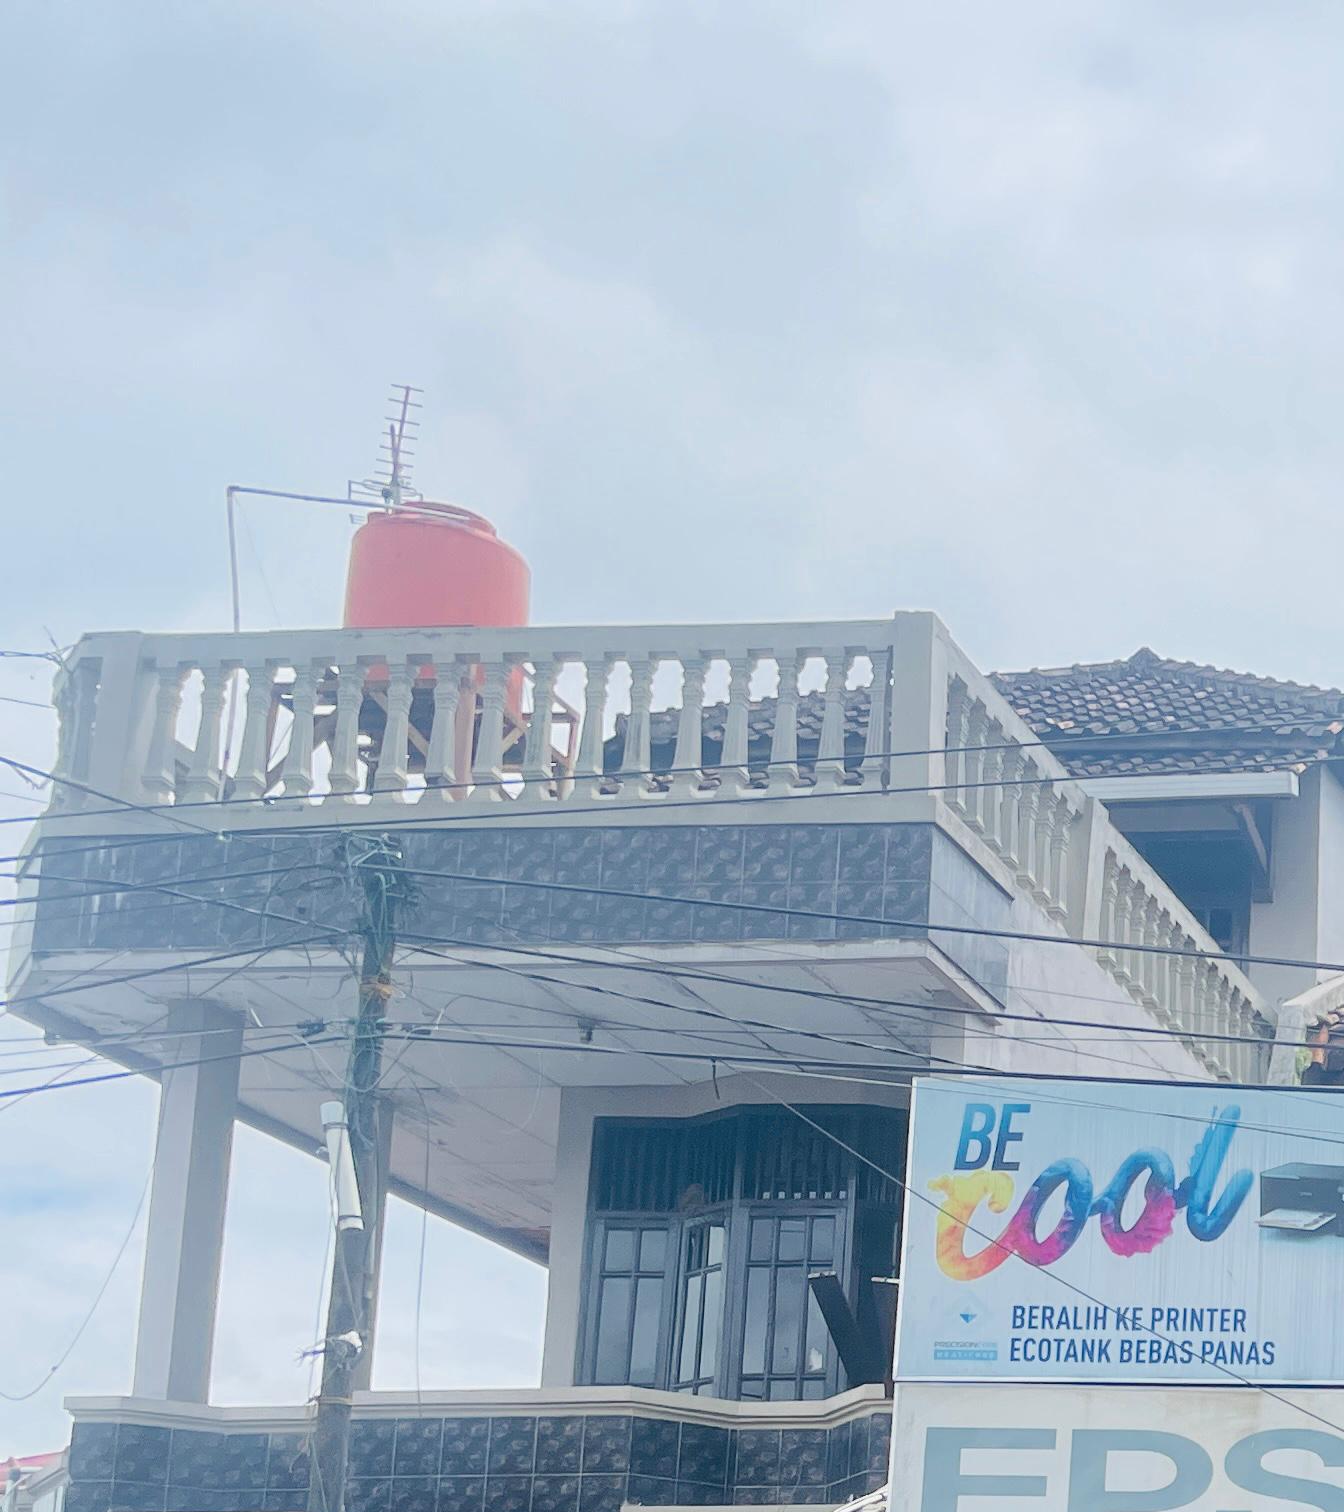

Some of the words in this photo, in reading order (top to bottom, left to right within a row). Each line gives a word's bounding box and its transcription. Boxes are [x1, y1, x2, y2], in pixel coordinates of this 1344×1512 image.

[953, 1103, 1030, 1172] BE
[1012, 1306, 1106, 1330] BERALIH
[1116, 1307, 1143, 1331] KE
[1151, 1308, 1247, 1332] PRINTER
[1009, 1338, 1112, 1363] ECOTANK
[1119, 1339, 1193, 1364] BEBAS
[1201, 1341, 1275, 1365] PANAS
